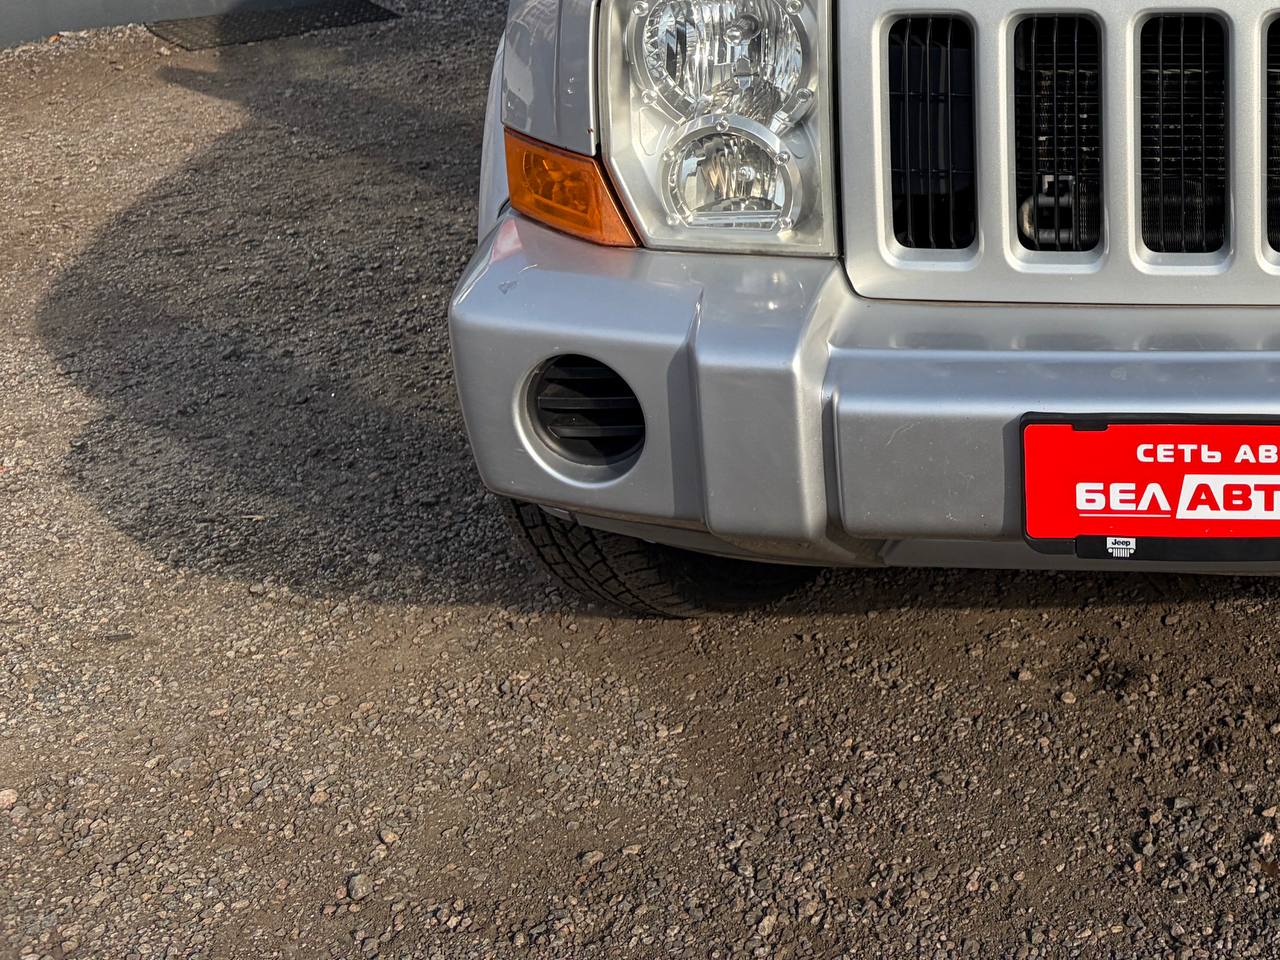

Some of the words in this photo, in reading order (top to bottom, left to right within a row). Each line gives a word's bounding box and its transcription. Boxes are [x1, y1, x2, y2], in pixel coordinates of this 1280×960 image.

[1136, 443, 1222, 464] СЕТЬ
[1075, 482, 1171, 512] БЕЛ
[1111, 539, 1131, 547] Jeep
